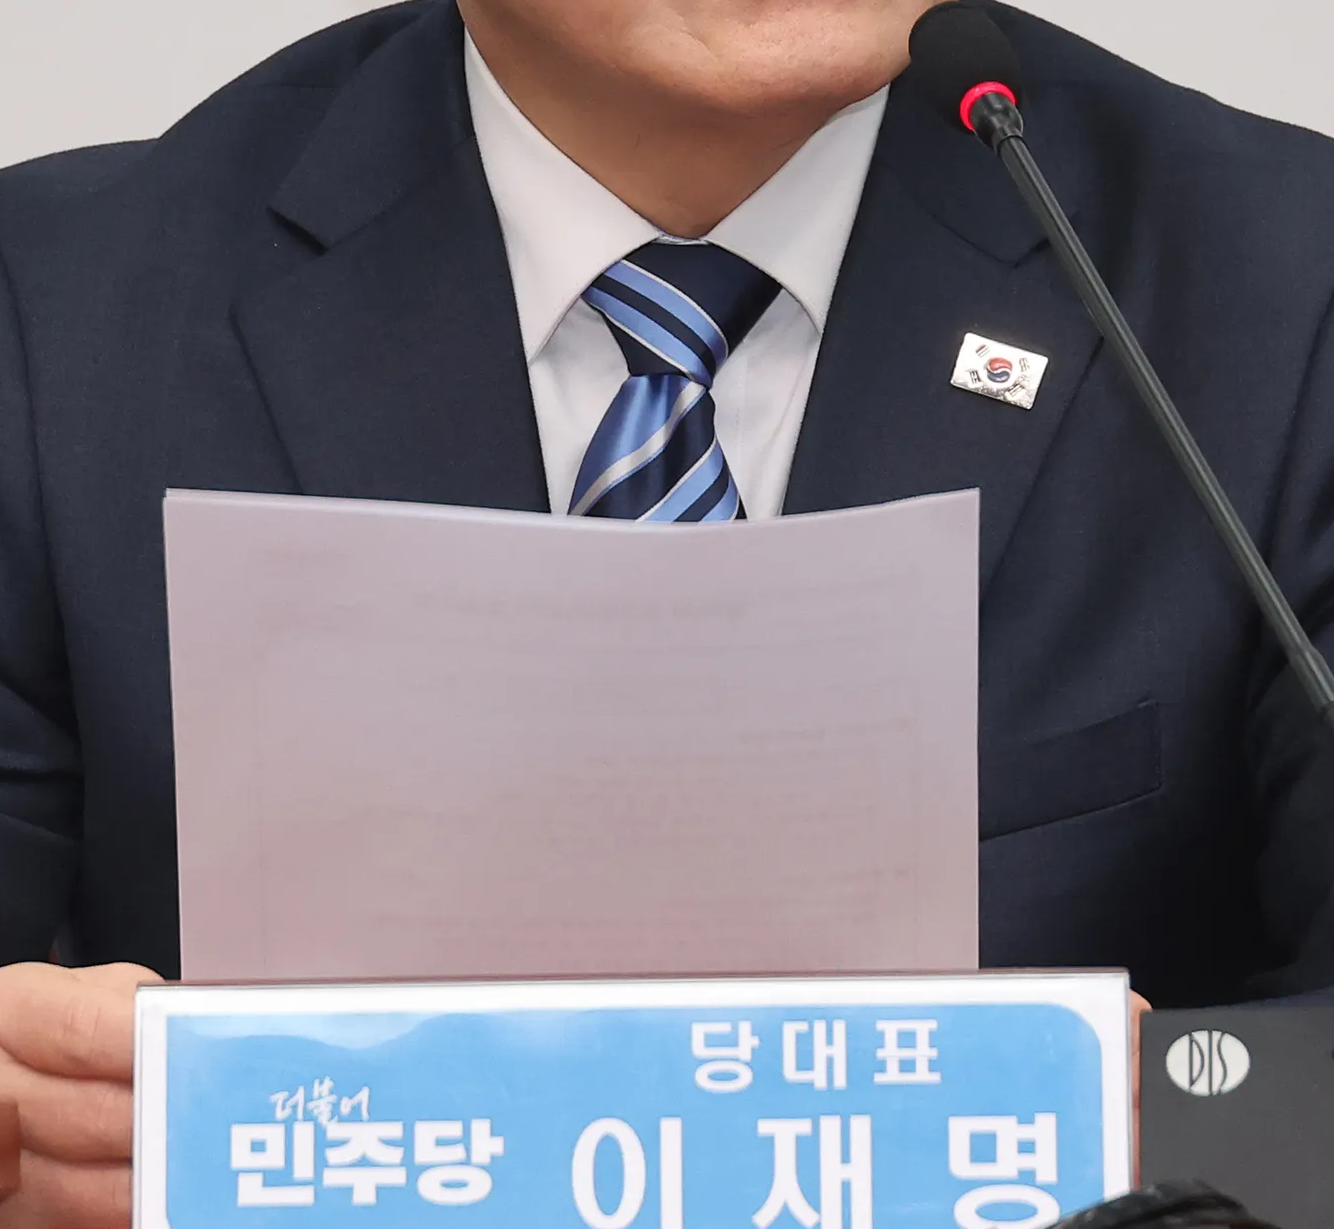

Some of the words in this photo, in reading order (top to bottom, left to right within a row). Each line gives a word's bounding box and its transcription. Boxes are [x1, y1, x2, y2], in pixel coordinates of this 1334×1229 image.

[690, 1018, 942, 1094] 당대표
[1186, 1029, 1231, 1097] DIS
[269, 1076, 371, 1128] 더불어
[230, 1118, 506, 1207] 민주당
[571, 1112, 1061, 1229] 이재명
